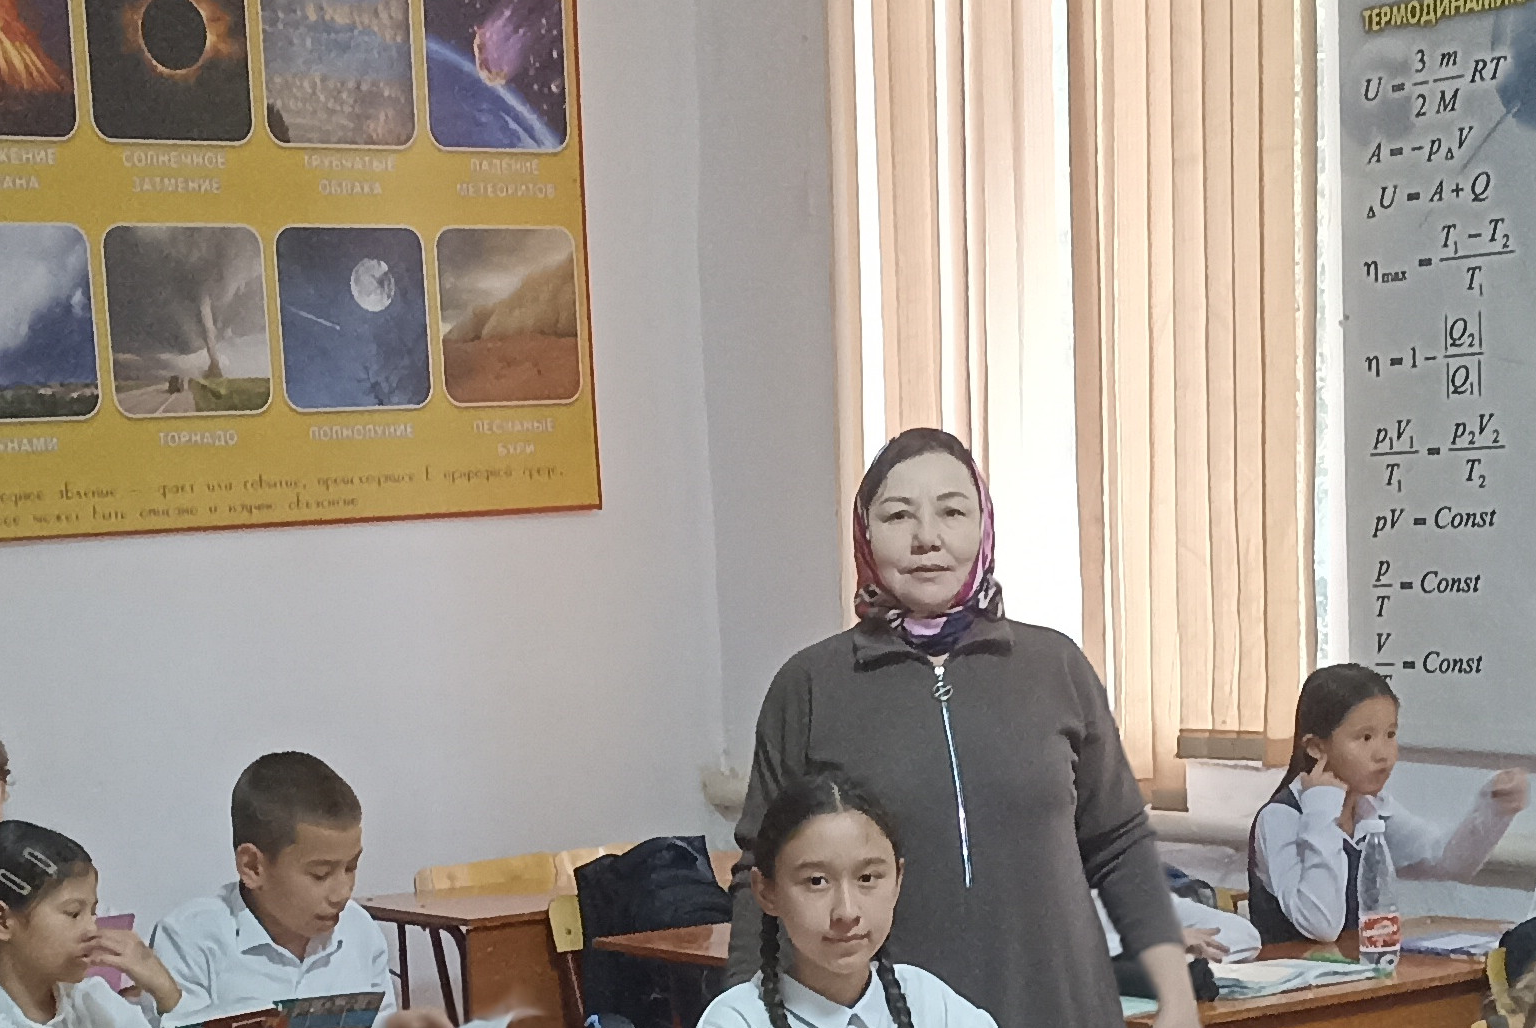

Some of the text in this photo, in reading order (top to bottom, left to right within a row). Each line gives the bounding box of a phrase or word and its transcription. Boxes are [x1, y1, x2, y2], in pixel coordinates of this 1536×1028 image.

[122, 149, 227, 169] СОЛНЕЧНОЕ
[132, 176, 223, 195] ЗАТМЕНИЕ
[158, 430, 239, 447] ТОРНАДО
[309, 423, 414, 441] ПОЛНОЛУНИЕ
[1434, 506, 1497, 530] Const
[1420, 570, 1481, 594] Const
[1422, 650, 1483, 674] Const
